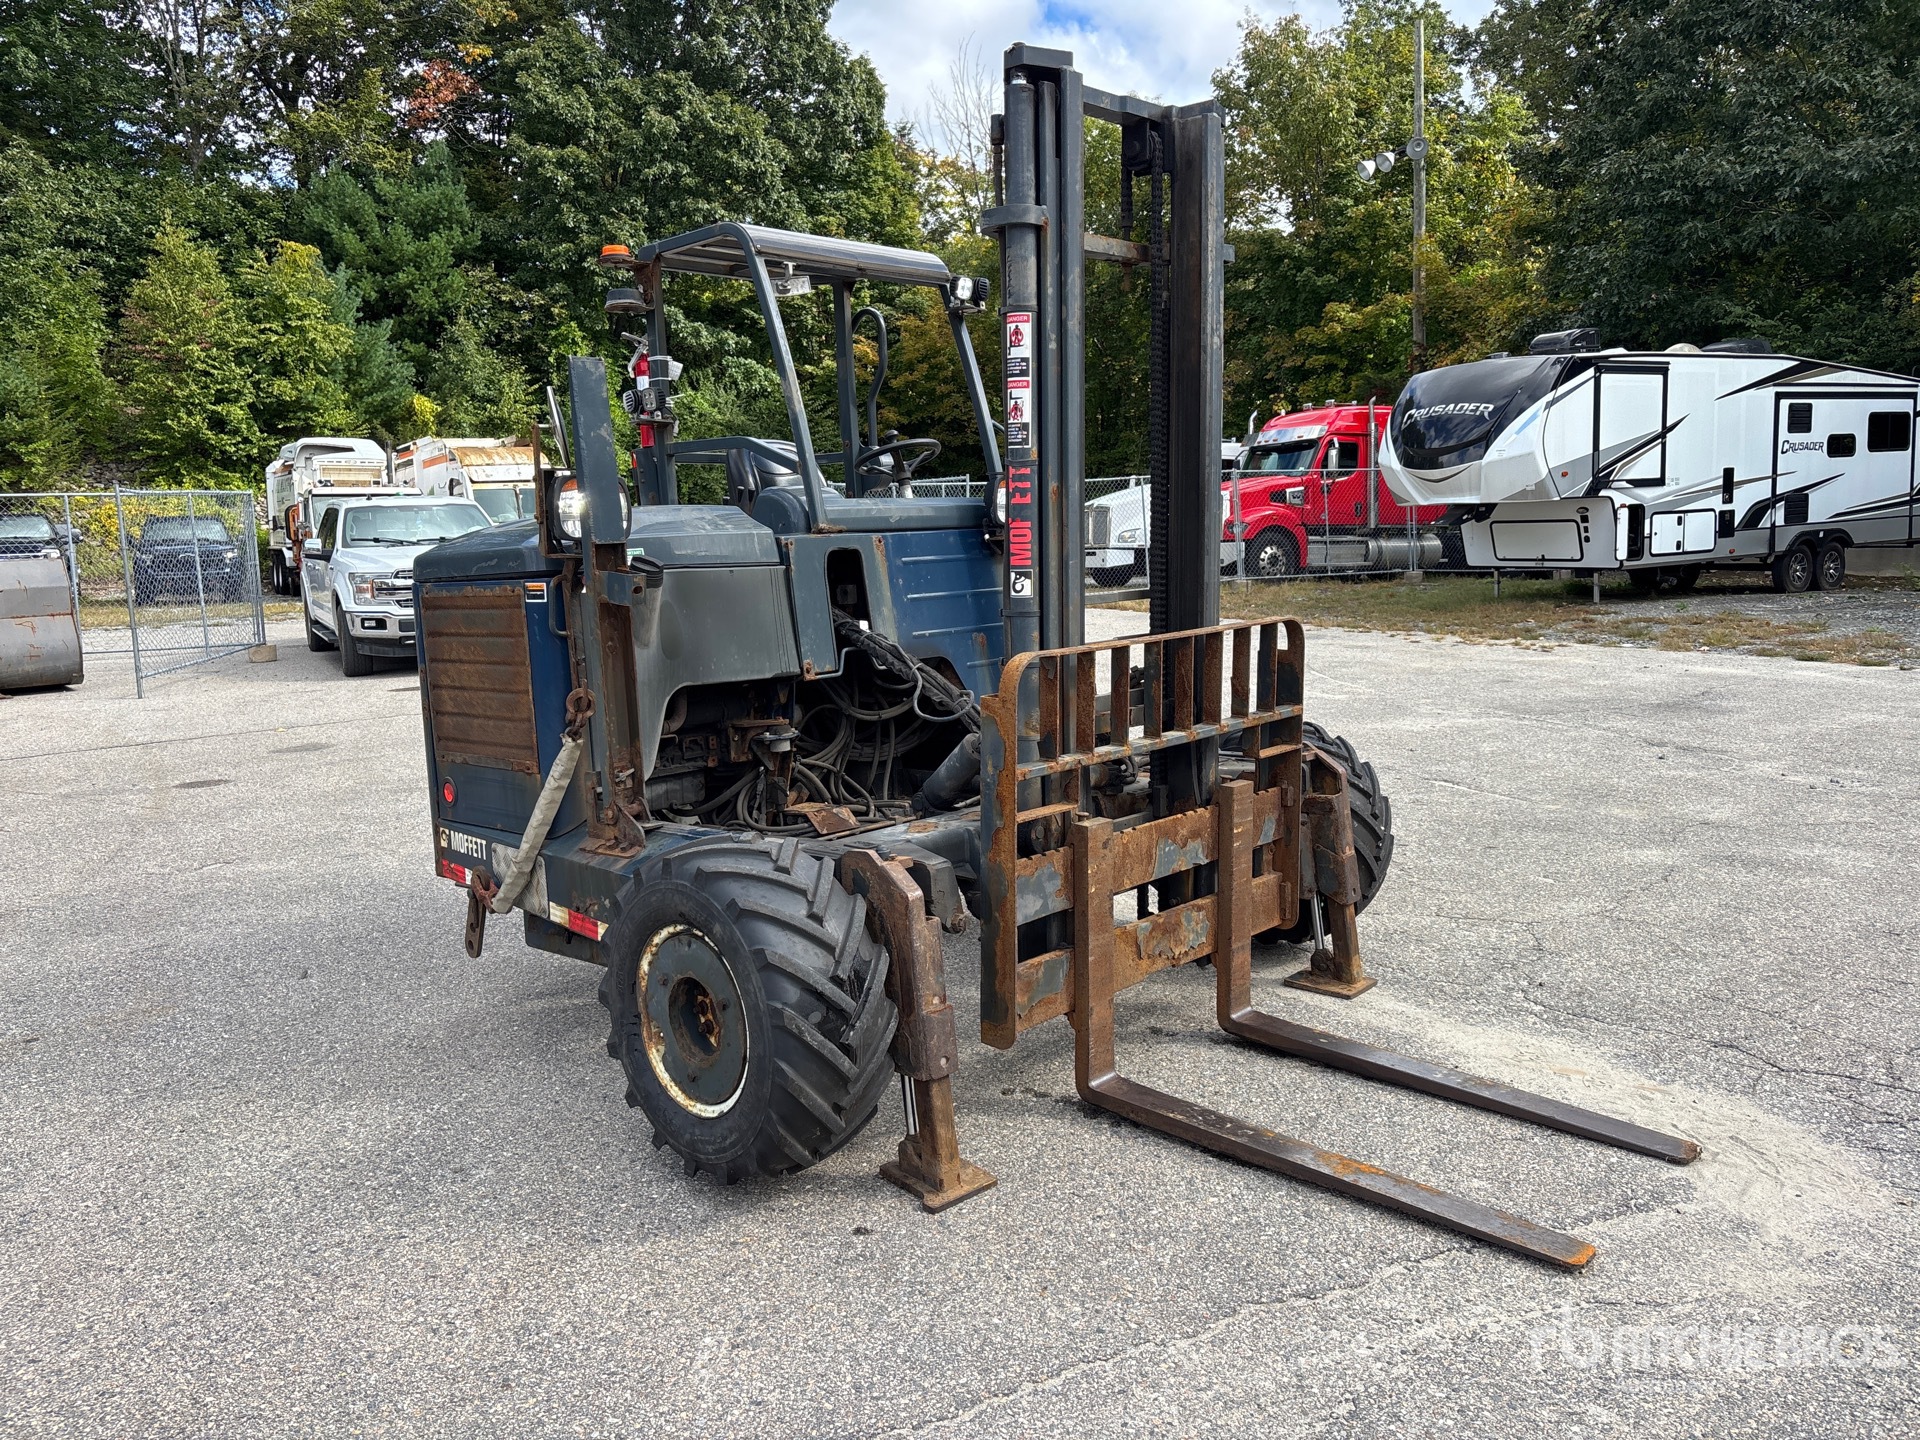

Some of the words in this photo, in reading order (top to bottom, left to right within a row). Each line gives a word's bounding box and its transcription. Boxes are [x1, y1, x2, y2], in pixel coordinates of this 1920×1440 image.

[1401, 403, 1495, 431] CRUSADER
[1781, 440, 1825, 454] CRUSADER
[450, 830, 487, 860] MOFFETT
